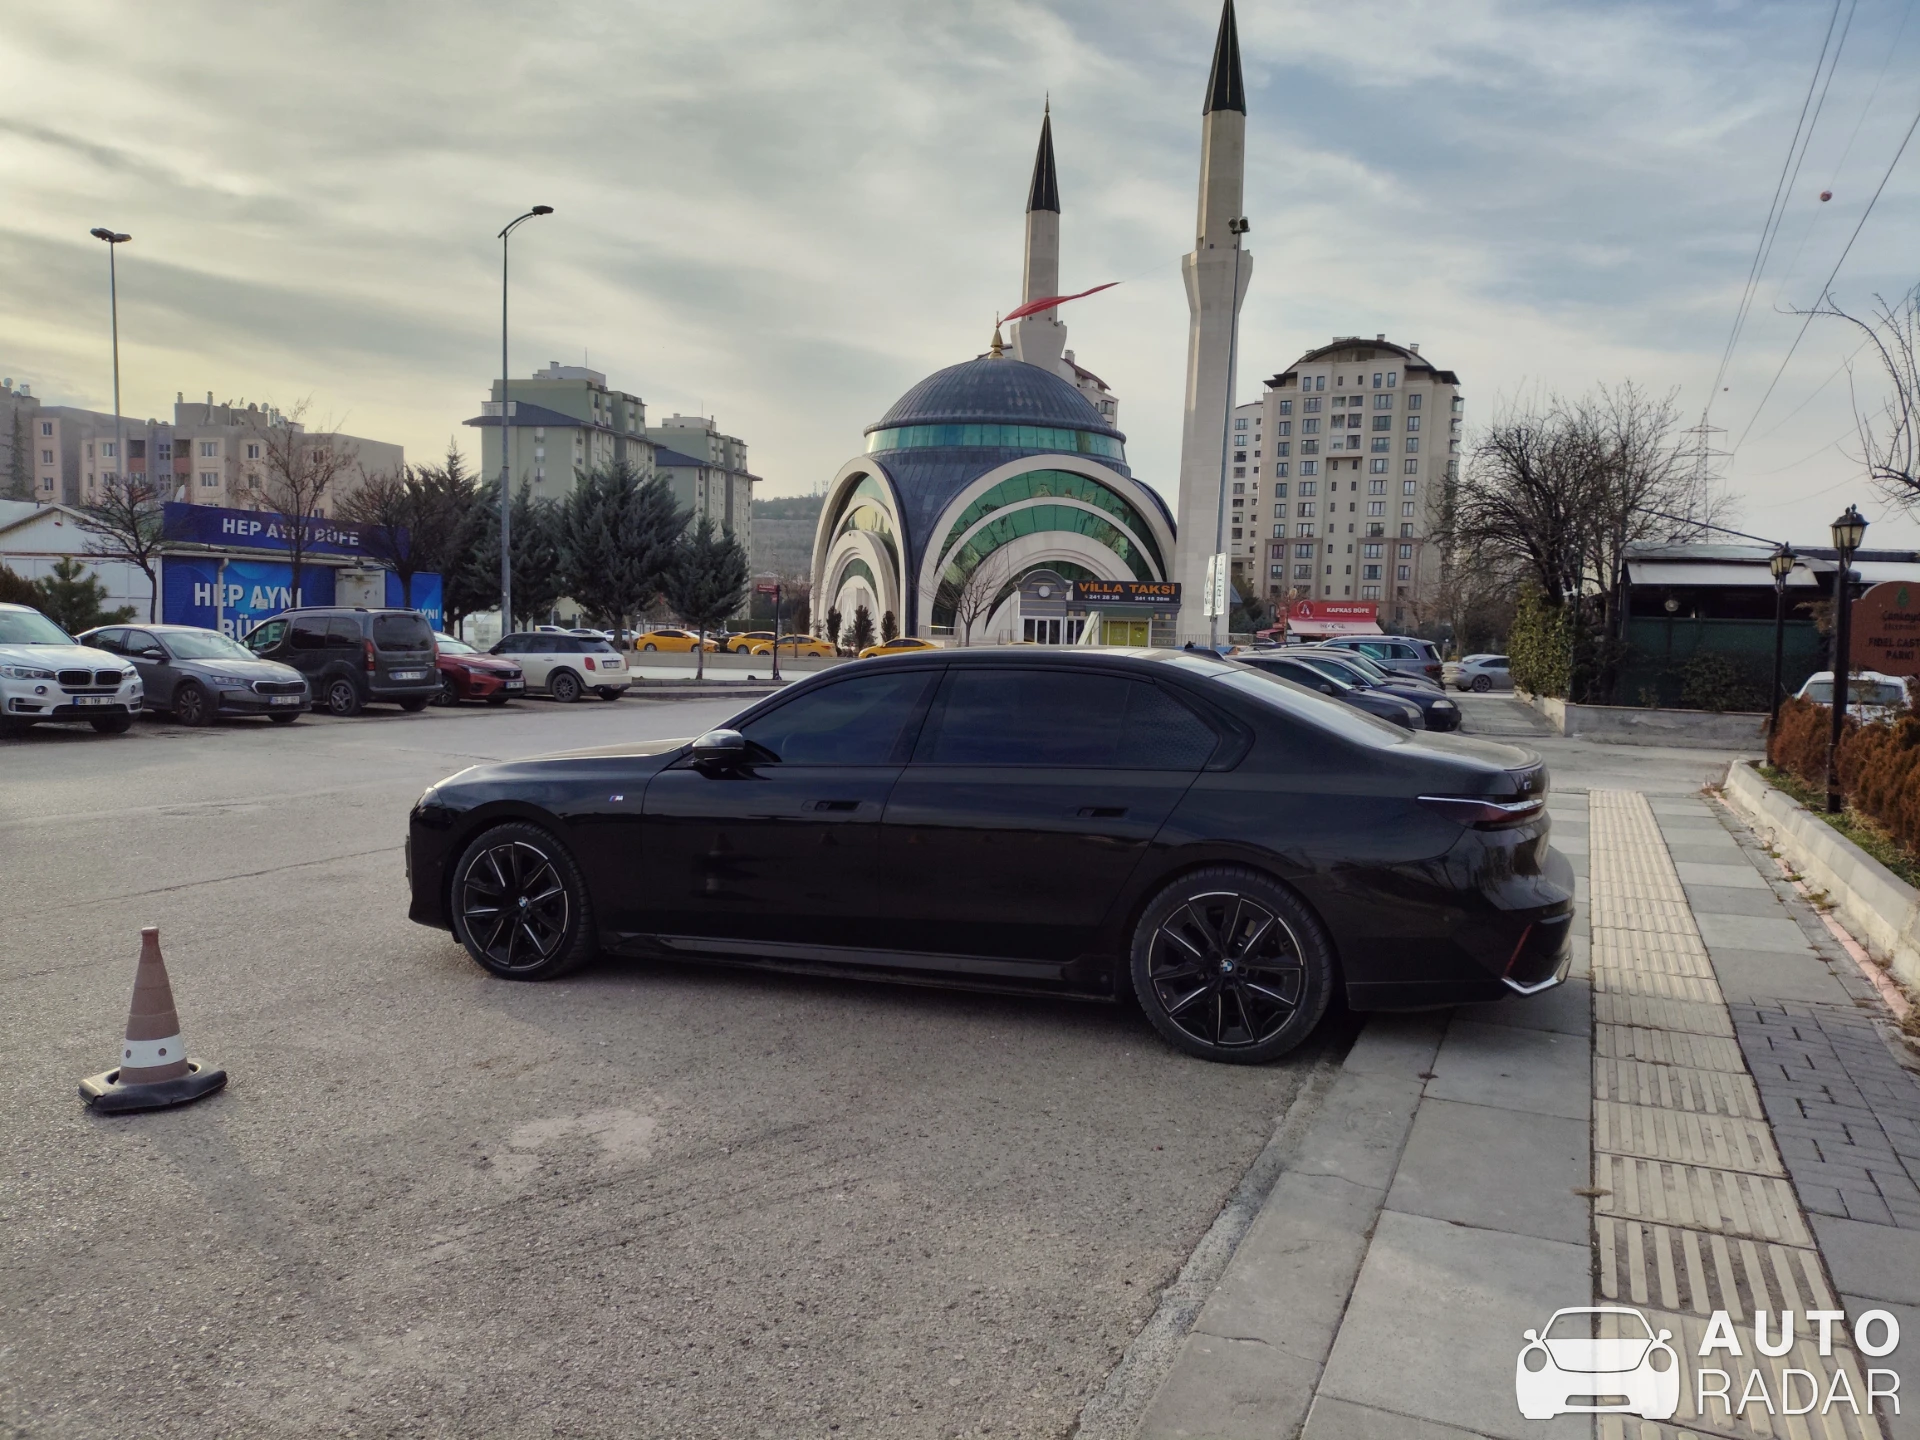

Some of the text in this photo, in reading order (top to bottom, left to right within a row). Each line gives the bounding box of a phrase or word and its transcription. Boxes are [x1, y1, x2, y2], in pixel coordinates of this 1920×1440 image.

[222, 518, 262, 536] HEP
[314, 526, 360, 546] BÜFE
[194, 582, 303, 609] HEP AYNI
[1078, 580, 1176, 595] VİLLA TAKSİ
[1353, 606, 1370, 614] BÜFE
